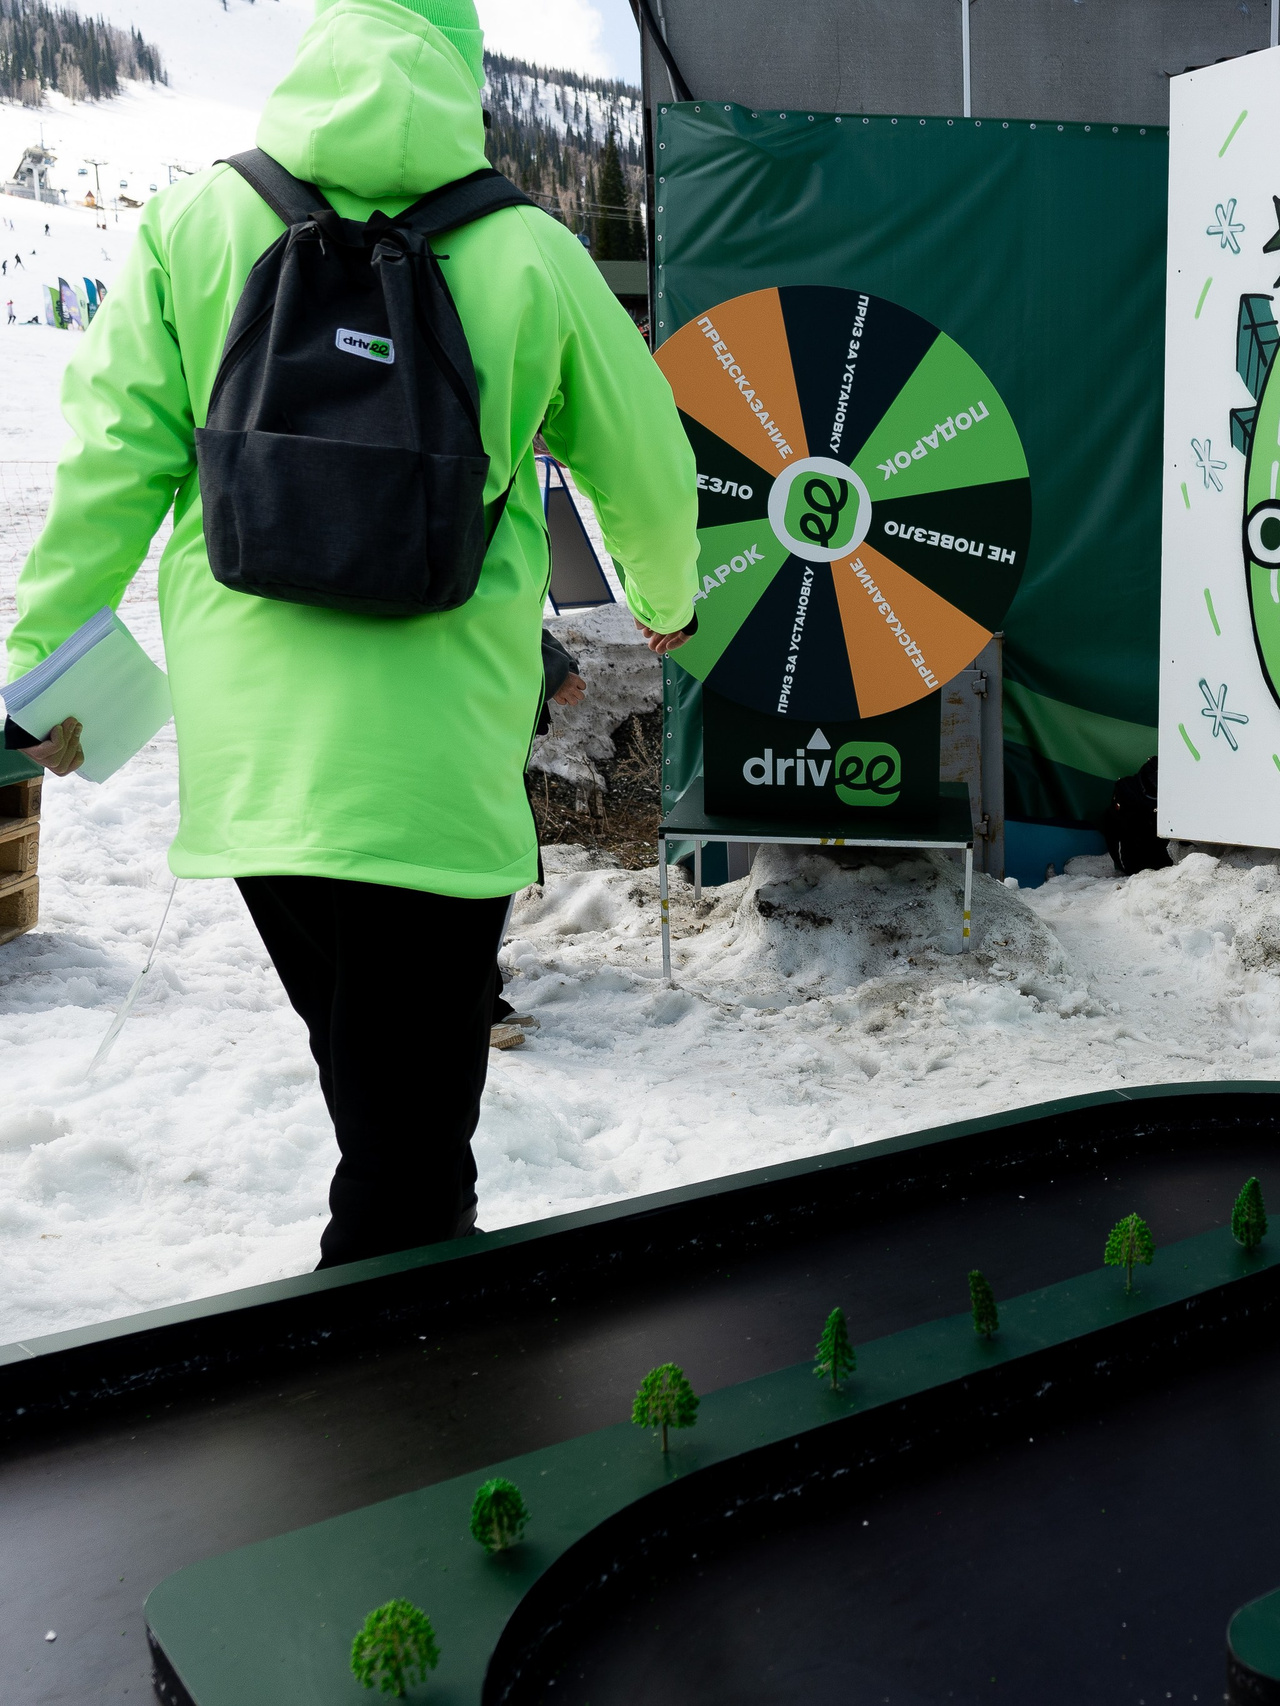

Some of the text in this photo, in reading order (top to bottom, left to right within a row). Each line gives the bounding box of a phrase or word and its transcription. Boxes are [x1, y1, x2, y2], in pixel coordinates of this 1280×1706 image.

[343, 336, 390, 358] drivee
[830, 295, 870, 453] ПРИЗ ЗА УСТАНОВКУ
[697, 316, 794, 459] ПРЕДСКАЗАНИЕ
[876, 400, 990, 481] ПОДАРОК
[696, 473, 754, 500] ЕЗЛО
[692, 543, 766, 606] АРОК
[884, 520, 1016, 565] НЕ ПОВЕЗЛО
[777, 566, 815, 714] ПРИЗ ЗА УСТАНОВКУ
[849, 557, 939, 689] ПРЕДСКАЗАНИЕ
[743, 748, 901, 797] drivee
